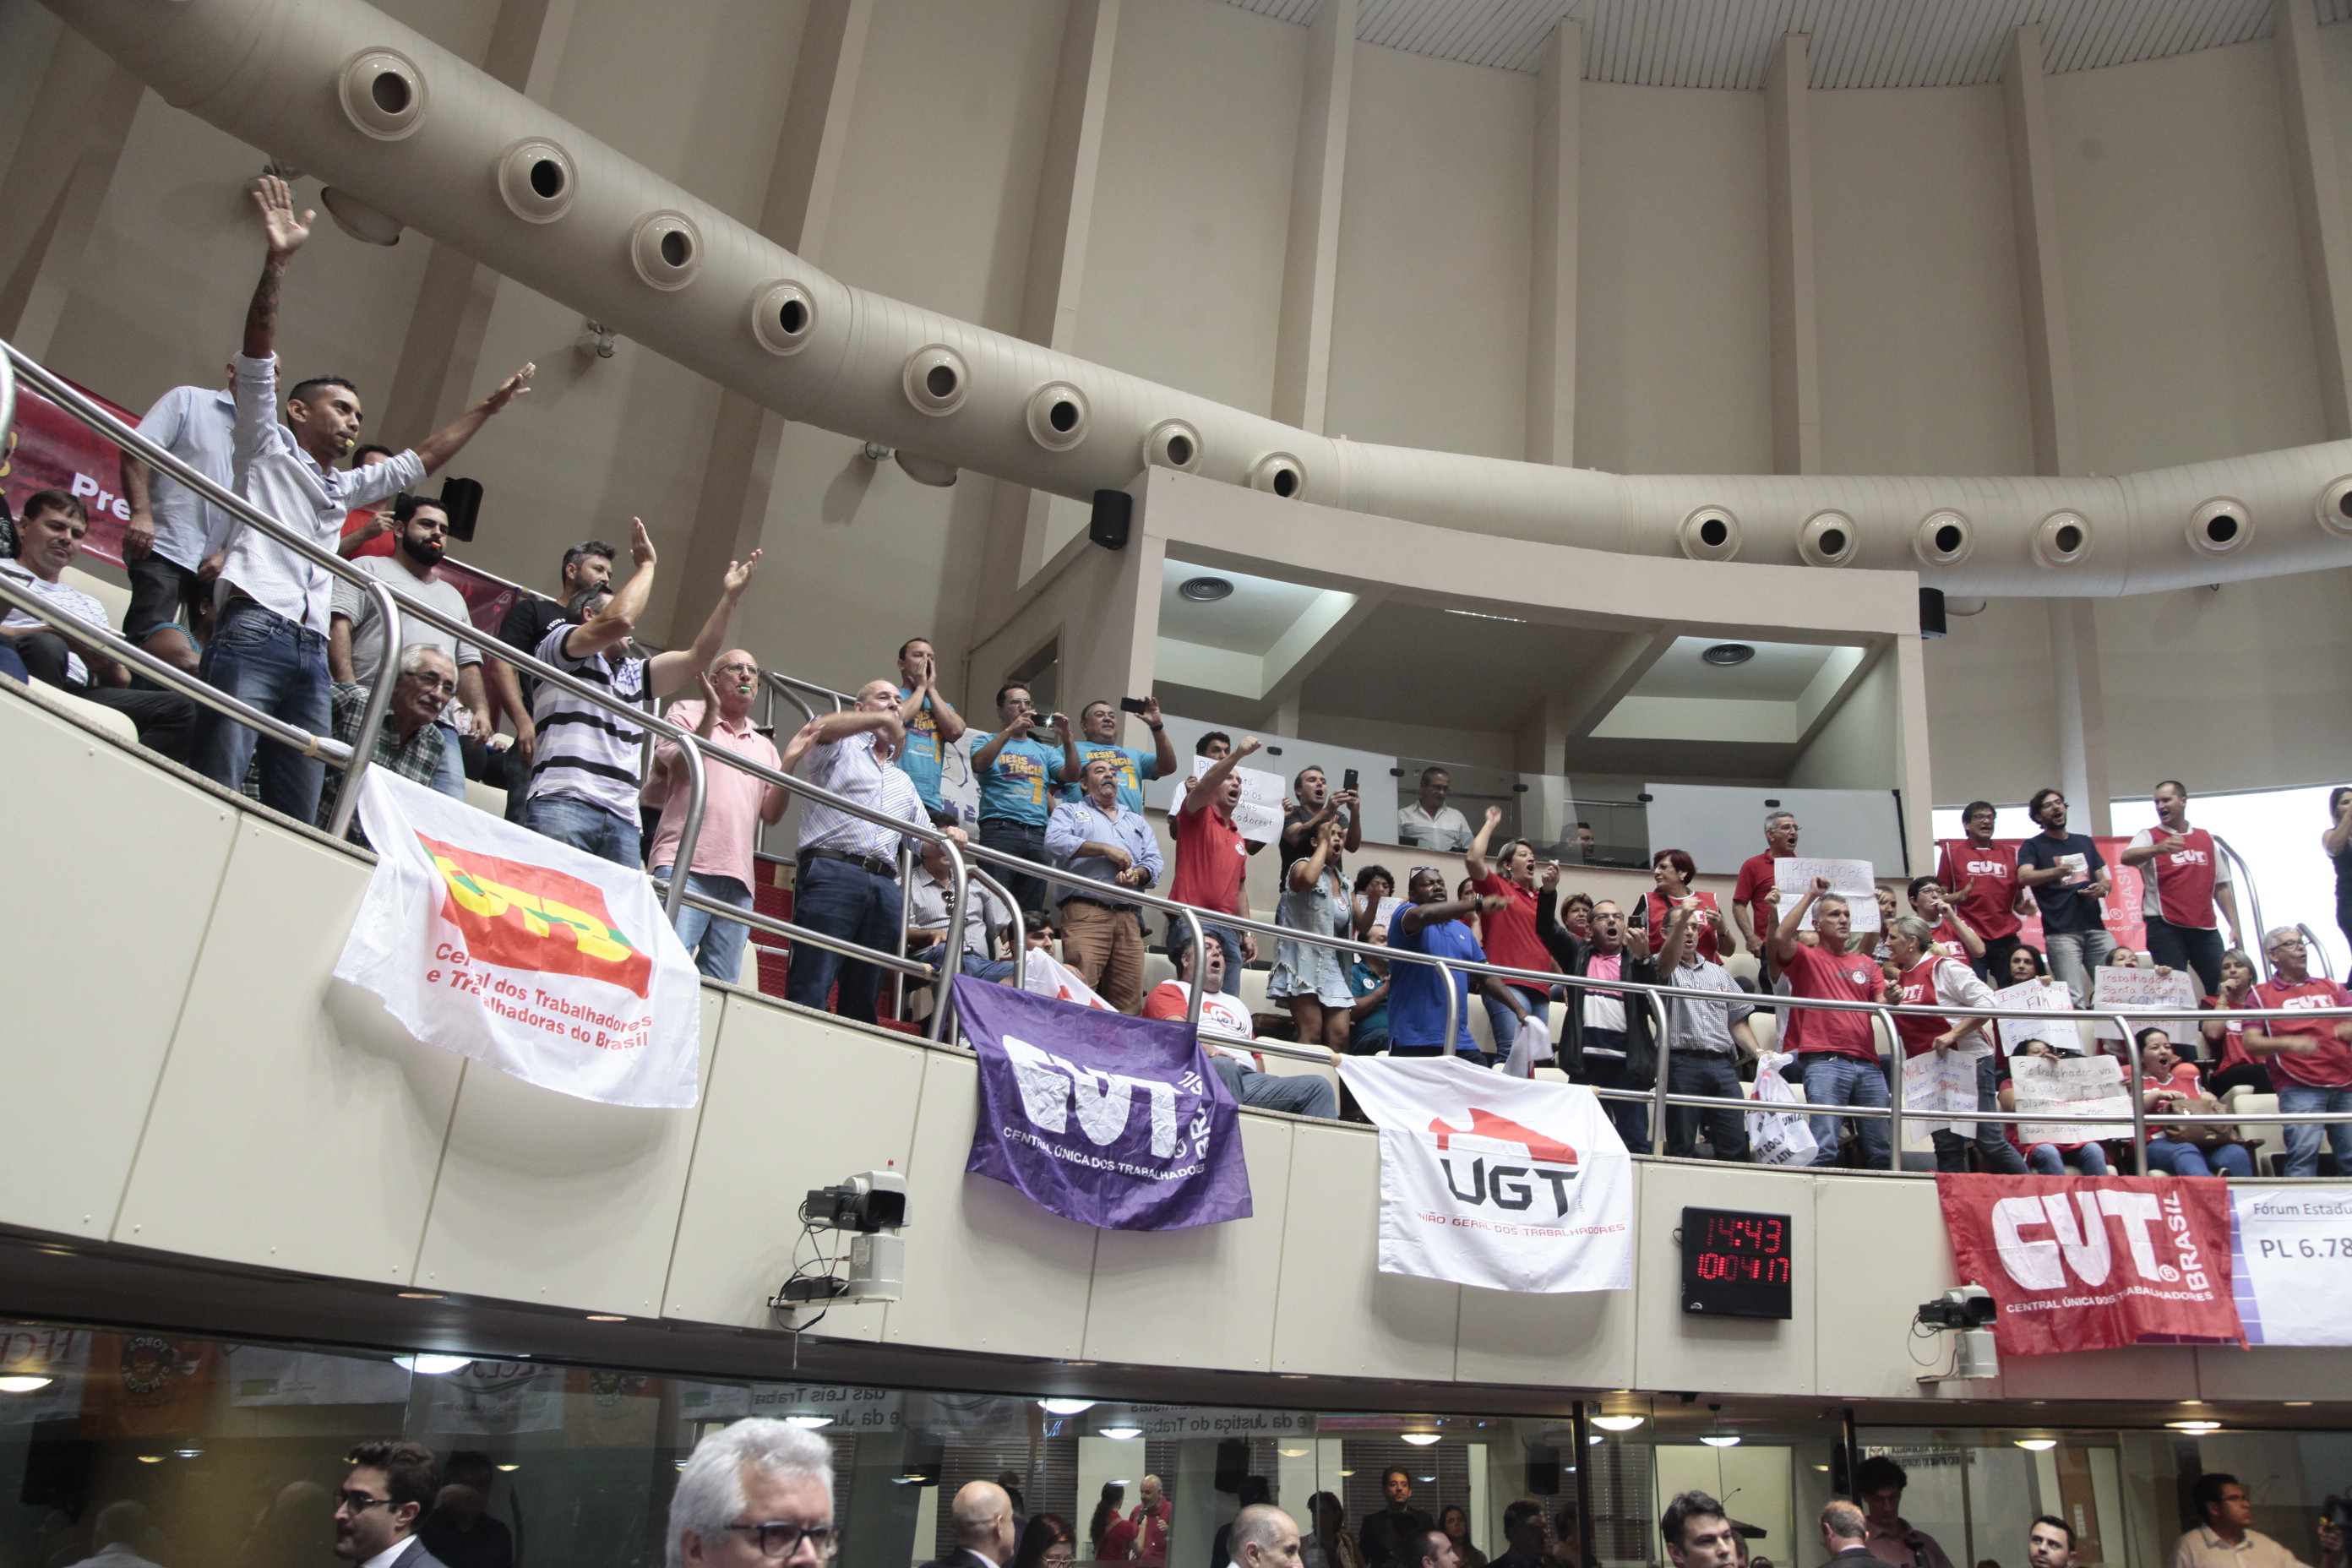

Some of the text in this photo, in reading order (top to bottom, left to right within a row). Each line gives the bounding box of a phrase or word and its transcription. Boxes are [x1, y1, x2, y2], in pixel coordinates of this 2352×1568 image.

[1966, 860, 2003, 875] CUT
[2170, 849, 2206, 864] CUT
[426, 969, 441, 983] e
[570, 1025, 591, 1043] do
[596, 1031, 649, 1051] Brasil
[494, 977, 528, 1001] dos
[535, 988, 653, 1034] Trabalhadores
[1054, 1144, 1090, 1168] ÚNICA
[1439, 1157, 1580, 1219] UGT
[2253, 1201, 2300, 1216] Fórum
[1452, 1218, 1492, 1232] GERAL
[1494, 1225, 1519, 1236] DOS
[1522, 1223, 1626, 1238] TRABALHADORES
[1707, 1217, 1783, 1254] 14:43
[1991, 1188, 2163, 1291] CUT
[2164, 1190, 2211, 1291] BRASIL
[2260, 1239, 2293, 1259] PL
[2006, 1299, 2061, 1313] CENTRAL
[2062, 1296, 2095, 1308] ÚNICA
